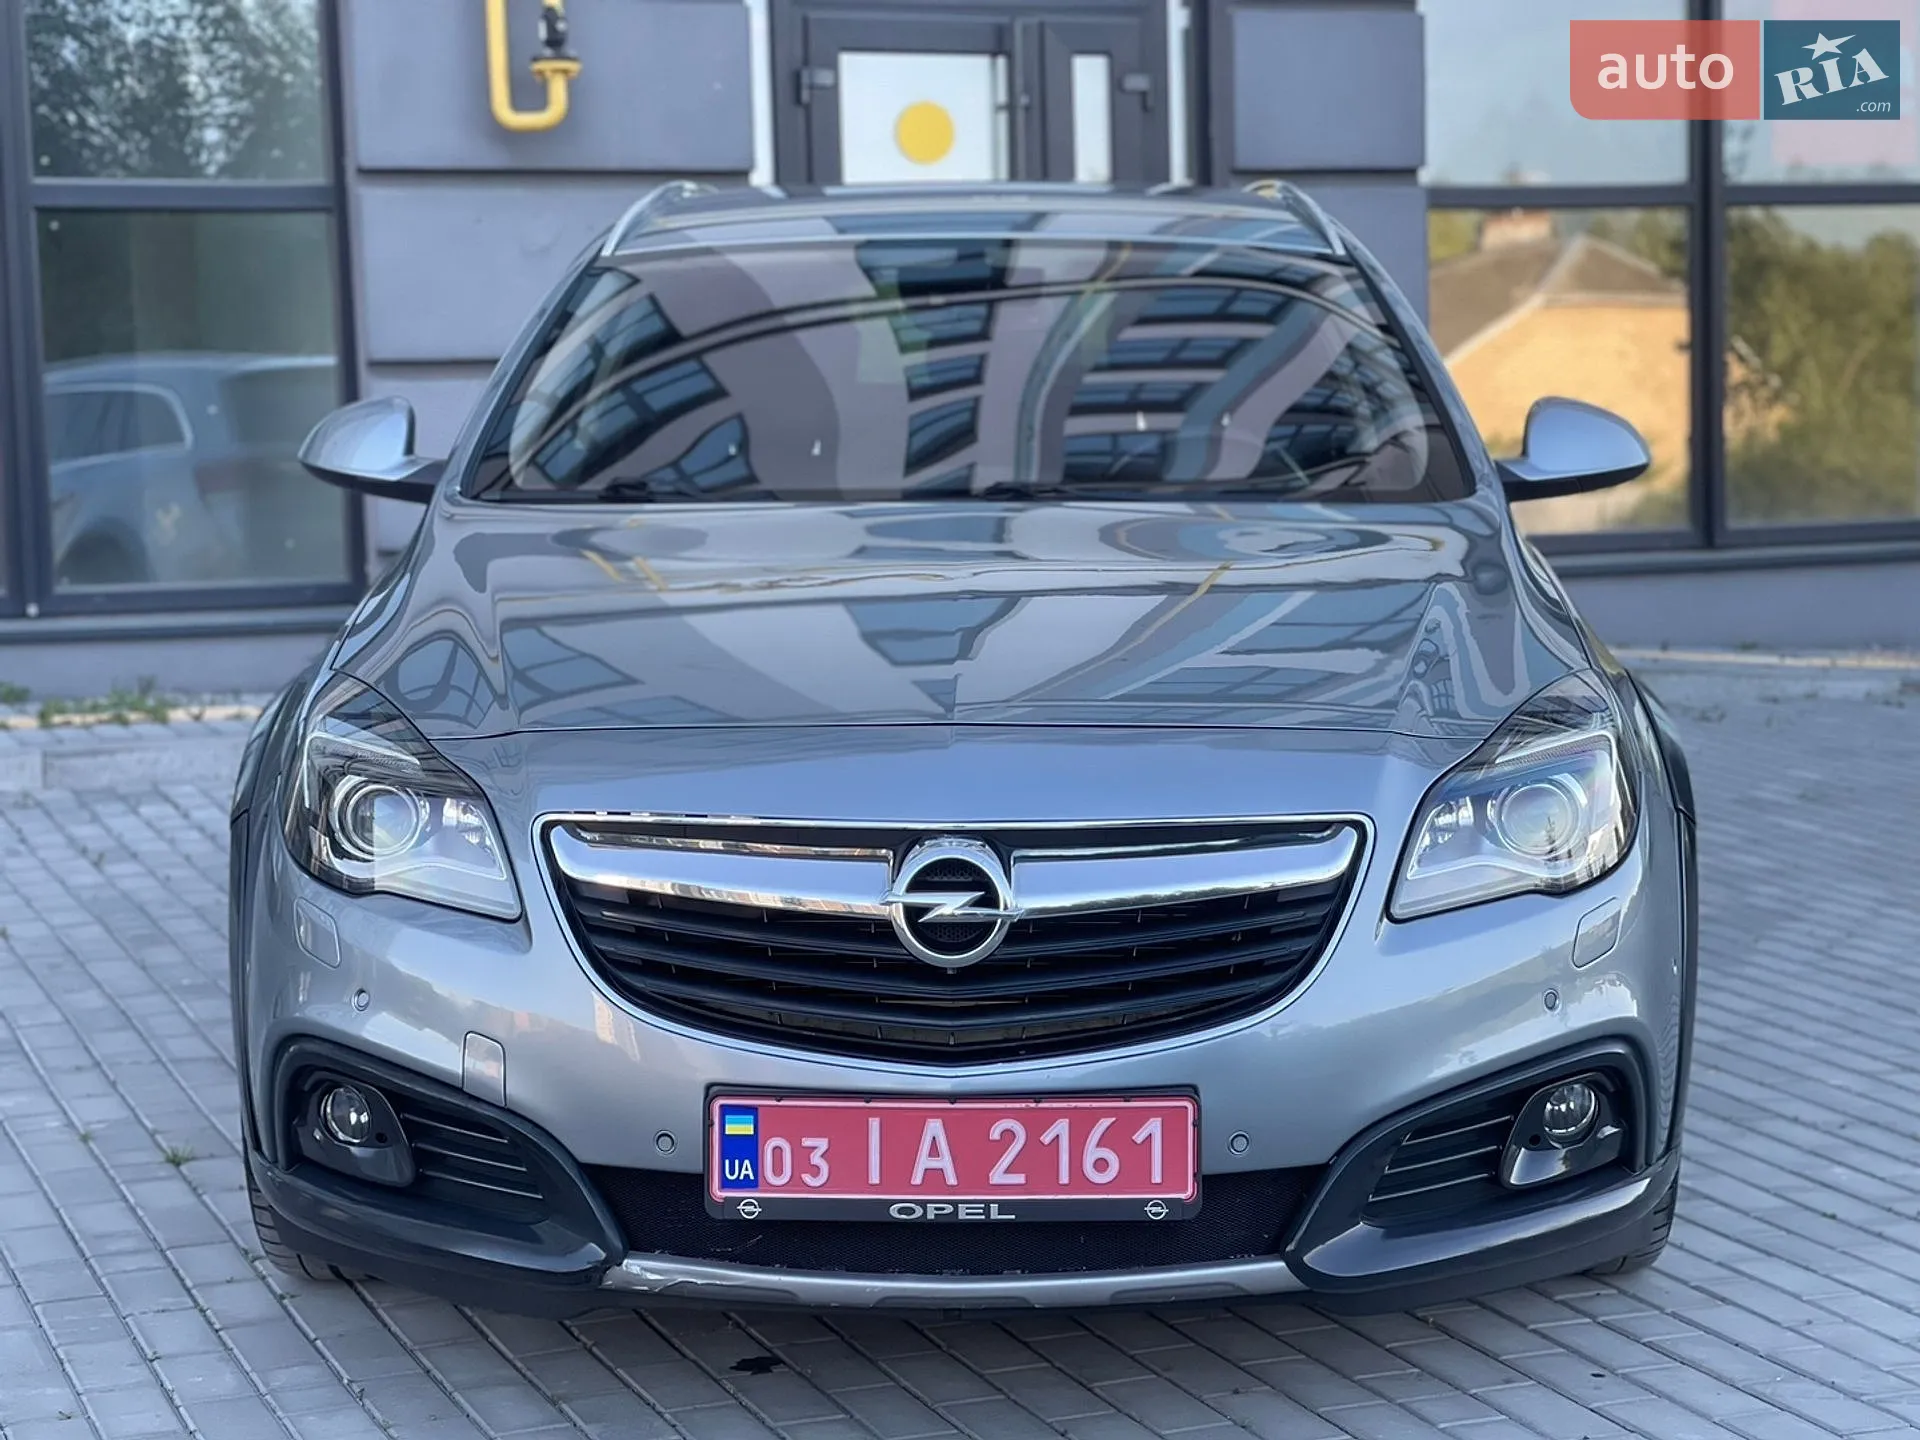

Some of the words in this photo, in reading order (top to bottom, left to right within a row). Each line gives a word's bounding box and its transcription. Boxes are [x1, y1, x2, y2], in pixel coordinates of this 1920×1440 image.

[763, 1136, 830, 1187] 03
[988, 1116, 1164, 1185] 2161
[724, 1158, 755, 1181] UA
[888, 1202, 1017, 1220] OPEL
